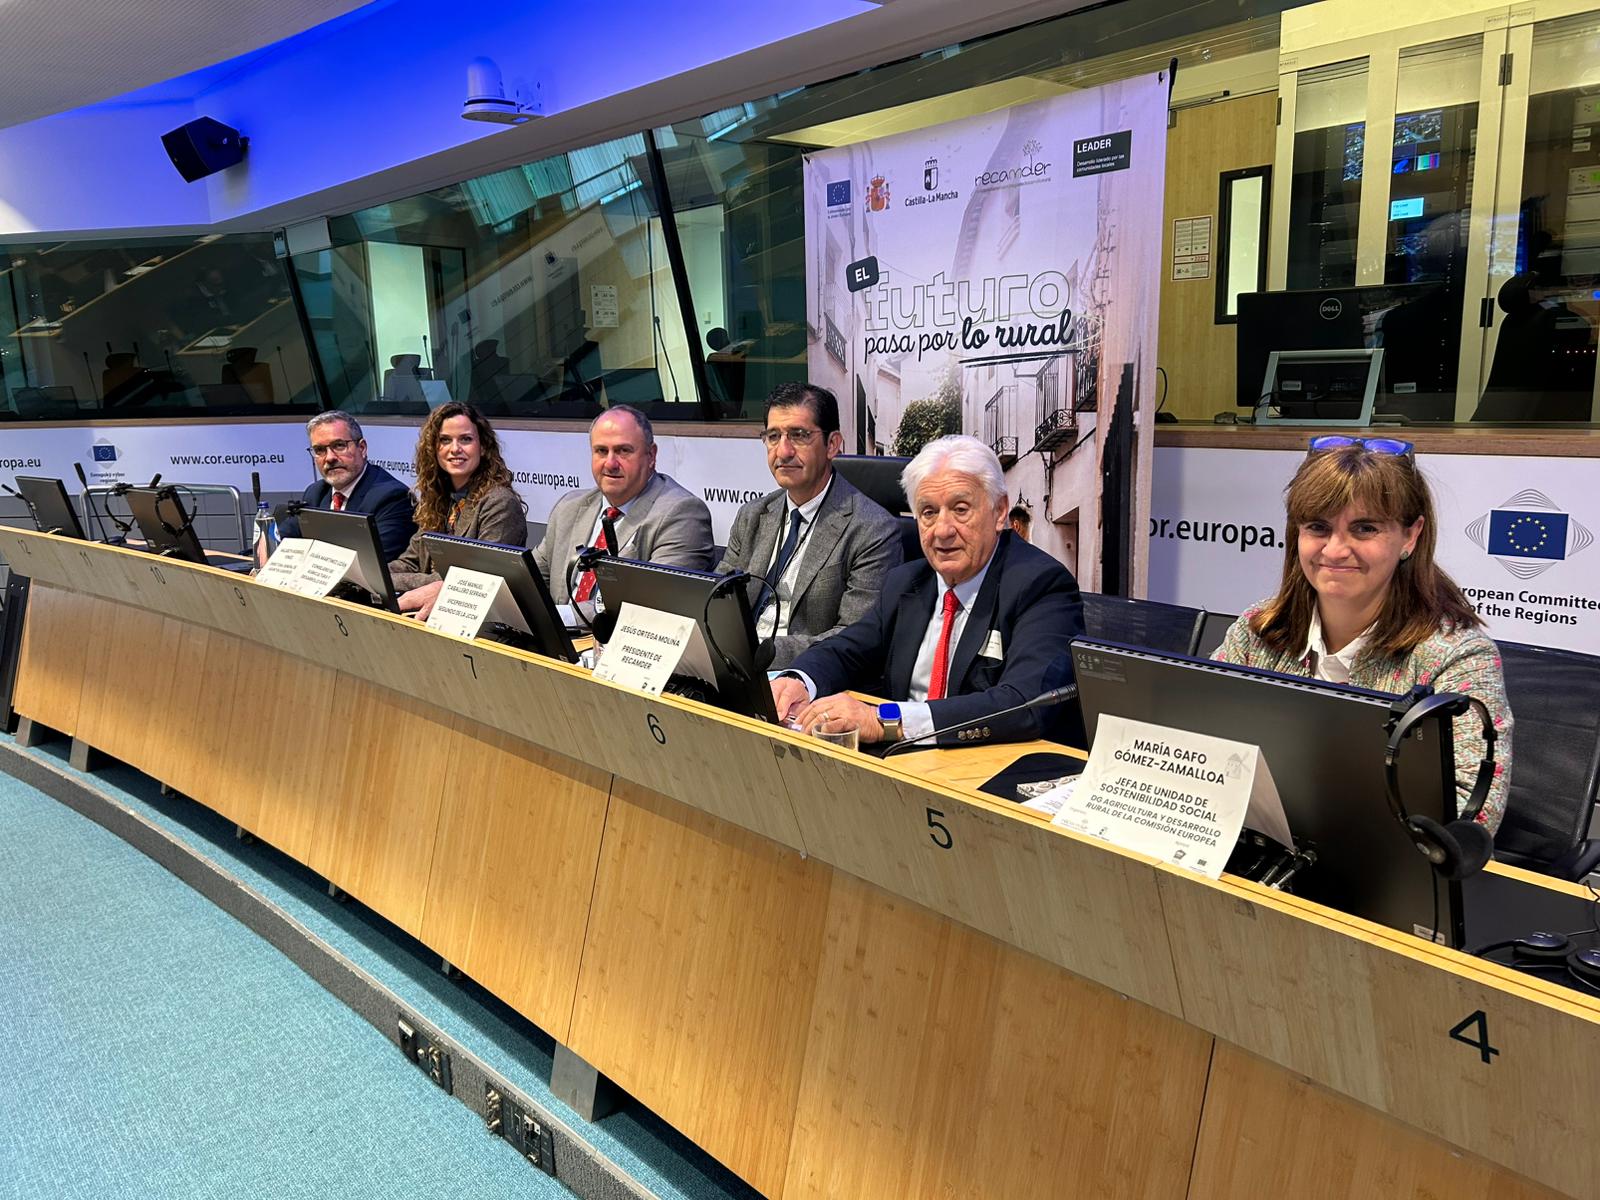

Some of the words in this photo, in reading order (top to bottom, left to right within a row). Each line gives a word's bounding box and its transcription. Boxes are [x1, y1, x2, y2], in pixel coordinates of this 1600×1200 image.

[1077, 138, 1112, 153] LEADER
[935, 190, 959, 201] Mancha
[855, 267, 870, 283] EL
[865, 270, 1070, 331] futuro
[864, 334, 915, 364] pasa
[918, 330, 958, 362] por
[961, 316, 990, 349] lo
[995, 308, 1075, 348] rural
[170, 453, 285, 468] www.cor.europa.eu
[17, 539, 31, 555] 12
[79, 551, 93, 567] 11
[150, 566, 166, 585] 10
[234, 587, 247, 607] 9
[1459, 587, 1514, 602] ropean
[334, 614, 349, 637] 8
[1486, 604, 1511, 618] the
[1515, 607, 1577, 625] Regions
[620, 625, 638, 636] JESÚS
[637, 629, 658, 641] ORTEGA
[658, 636, 680, 647] MOLINA
[621, 645, 653, 660] PRESIDENTE
[653, 654, 662, 662] DE
[621, 656, 652, 670] RECAMDER
[463, 653, 478, 680] 7
[646, 713, 667, 745] 6
[1133, 739, 1171, 757] MARÍA
[1173, 748, 1207, 765] GAFO
[1114, 749, 1225, 785] GÓMEZ-ZAMALLOA
[1099, 783, 1178, 811] SOSTENIBILIDAD
[1179, 805, 1217, 823] SOCIAL
[1115, 777, 1137, 790] JEFA
[1139, 782, 1153, 793] DE
[1153, 786, 1193, 804] UNIDAD
[1194, 796, 1209, 808] DE
[1085, 802, 1111, 814] RURAL
[1111, 810, 1122, 818] DE
[1122, 812, 1133, 822] LA
[1134, 815, 1176, 835] COMISIÓN
[1177, 829, 1217, 847] EUROPEA
[1090, 795, 1103, 803] DG
[1103, 799, 1158, 820] AGRICULTURA
[1166, 816, 1221, 838] DESARROLLO
[926, 807, 953, 850] 5
[1449, 1010, 1500, 1065] 4
